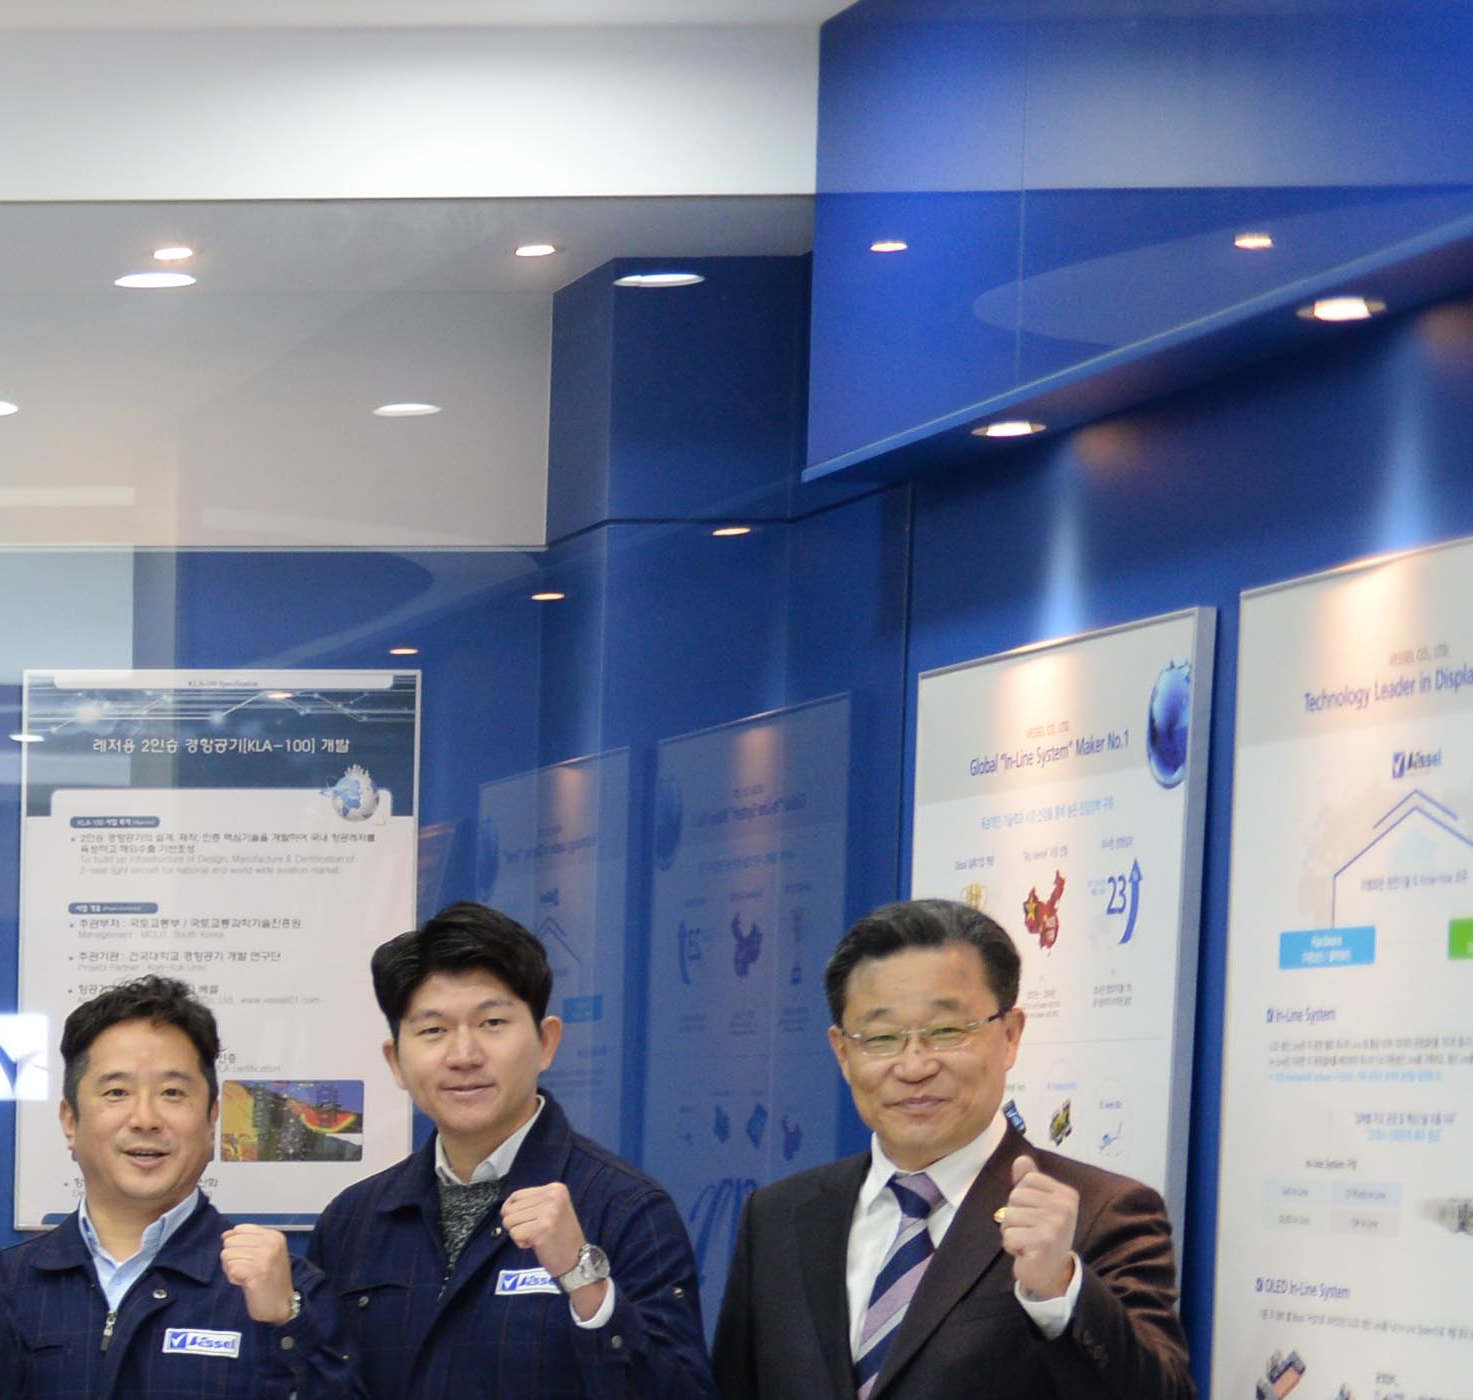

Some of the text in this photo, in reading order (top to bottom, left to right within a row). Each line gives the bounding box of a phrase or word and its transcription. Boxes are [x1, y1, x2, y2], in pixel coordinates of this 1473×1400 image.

[1303, 685, 1370, 713] Technology
[1374, 675, 1416, 702] Leader
[1419, 671, 1432, 693] in
[93, 738, 136, 754] 레저용
[141, 738, 178, 754] 2인승
[320, 738, 350, 754] 개발
[968, 752, 999, 777] Global
[1075, 735, 1106, 757] Maker
[1106, 875, 1127, 915] 23
[186, 1333, 237, 1351] Vessel
